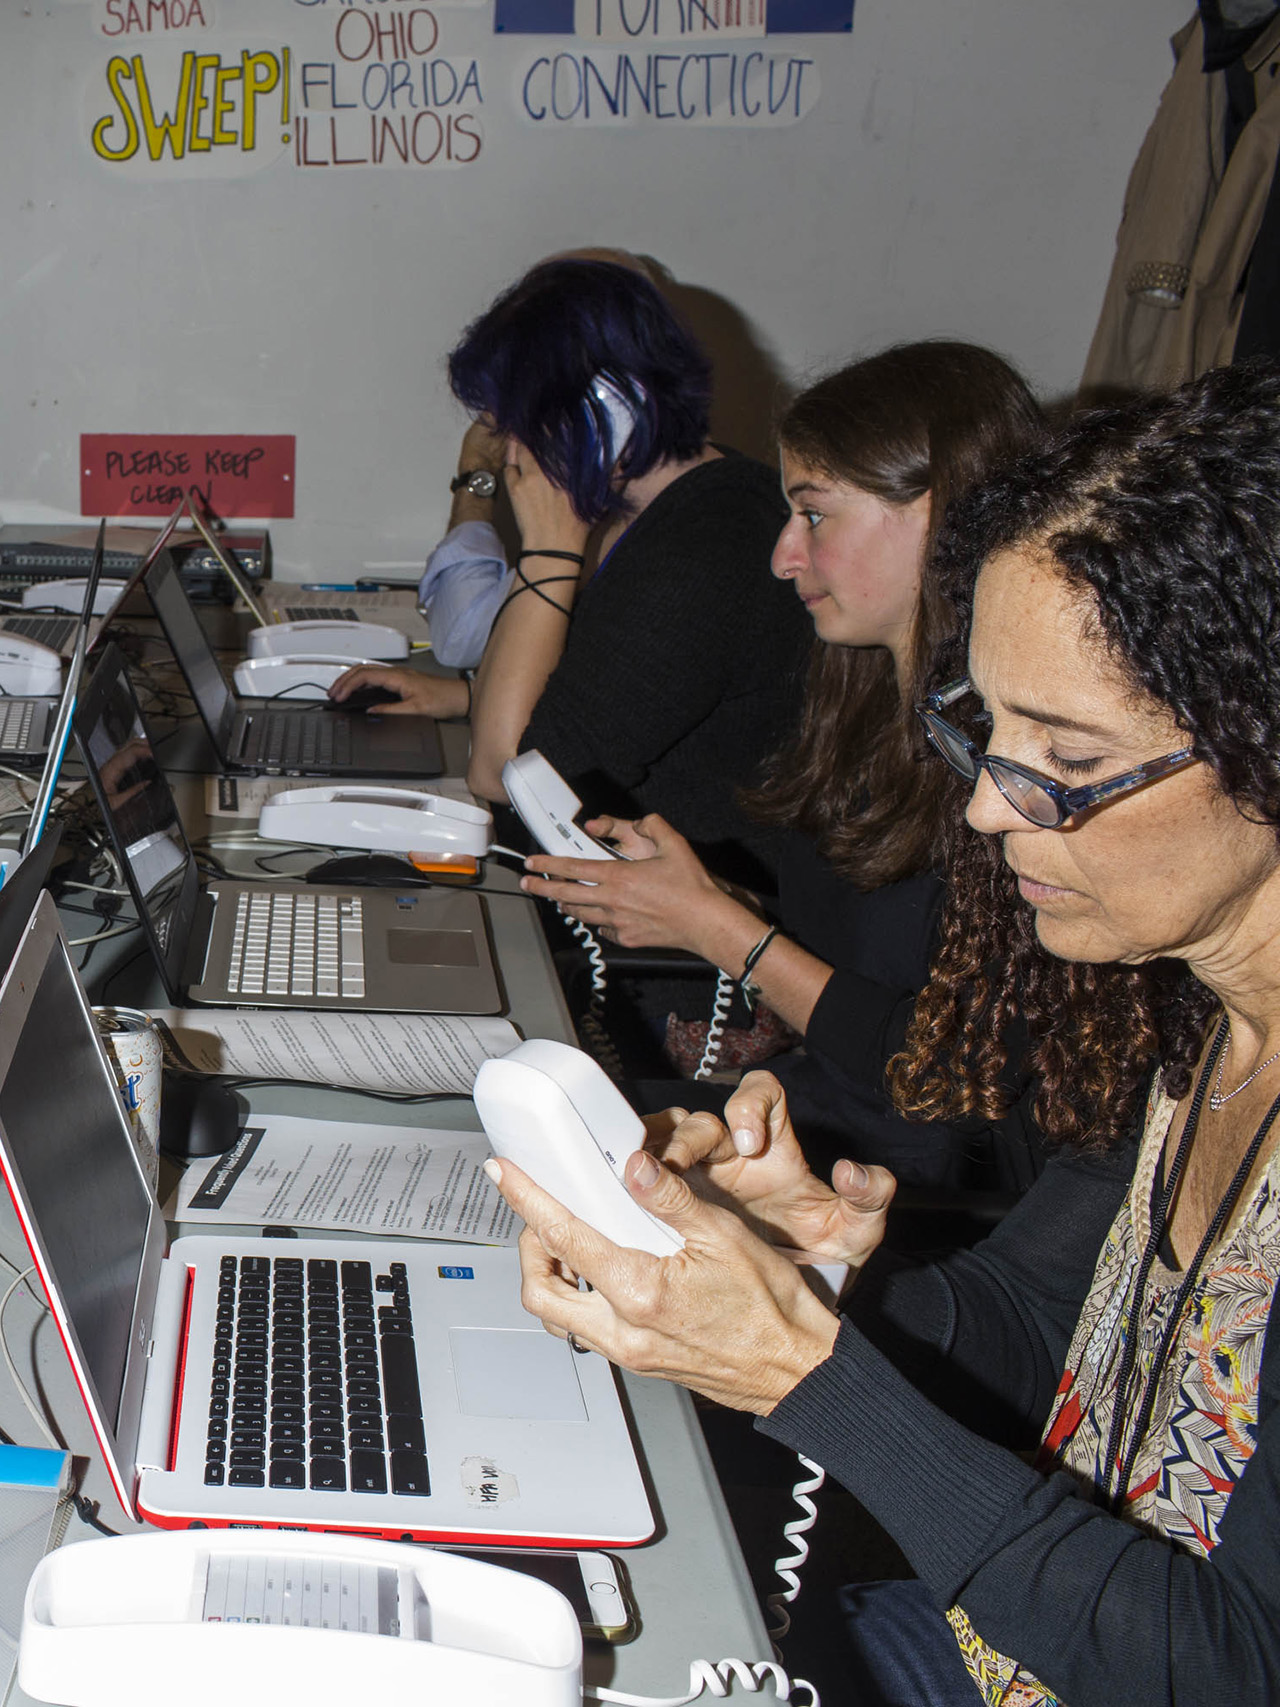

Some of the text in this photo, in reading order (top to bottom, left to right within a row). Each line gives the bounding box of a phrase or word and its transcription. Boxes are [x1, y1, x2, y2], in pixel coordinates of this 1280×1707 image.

[101, 0, 206, 36] SAMOA
[336, 8, 439, 61] OHIO
[91, 46, 292, 162] SWEEP!
[300, 60, 484, 111] FLORIDA
[523, 52, 814, 120] CONNECTICUT
[295, 111, 482, 168] ILLINOIS
[106, 446, 265, 480] PLEASE KEEP
[203, 1168, 235, 1195] Frequently
[229, 1132, 254, 1157] Questions
